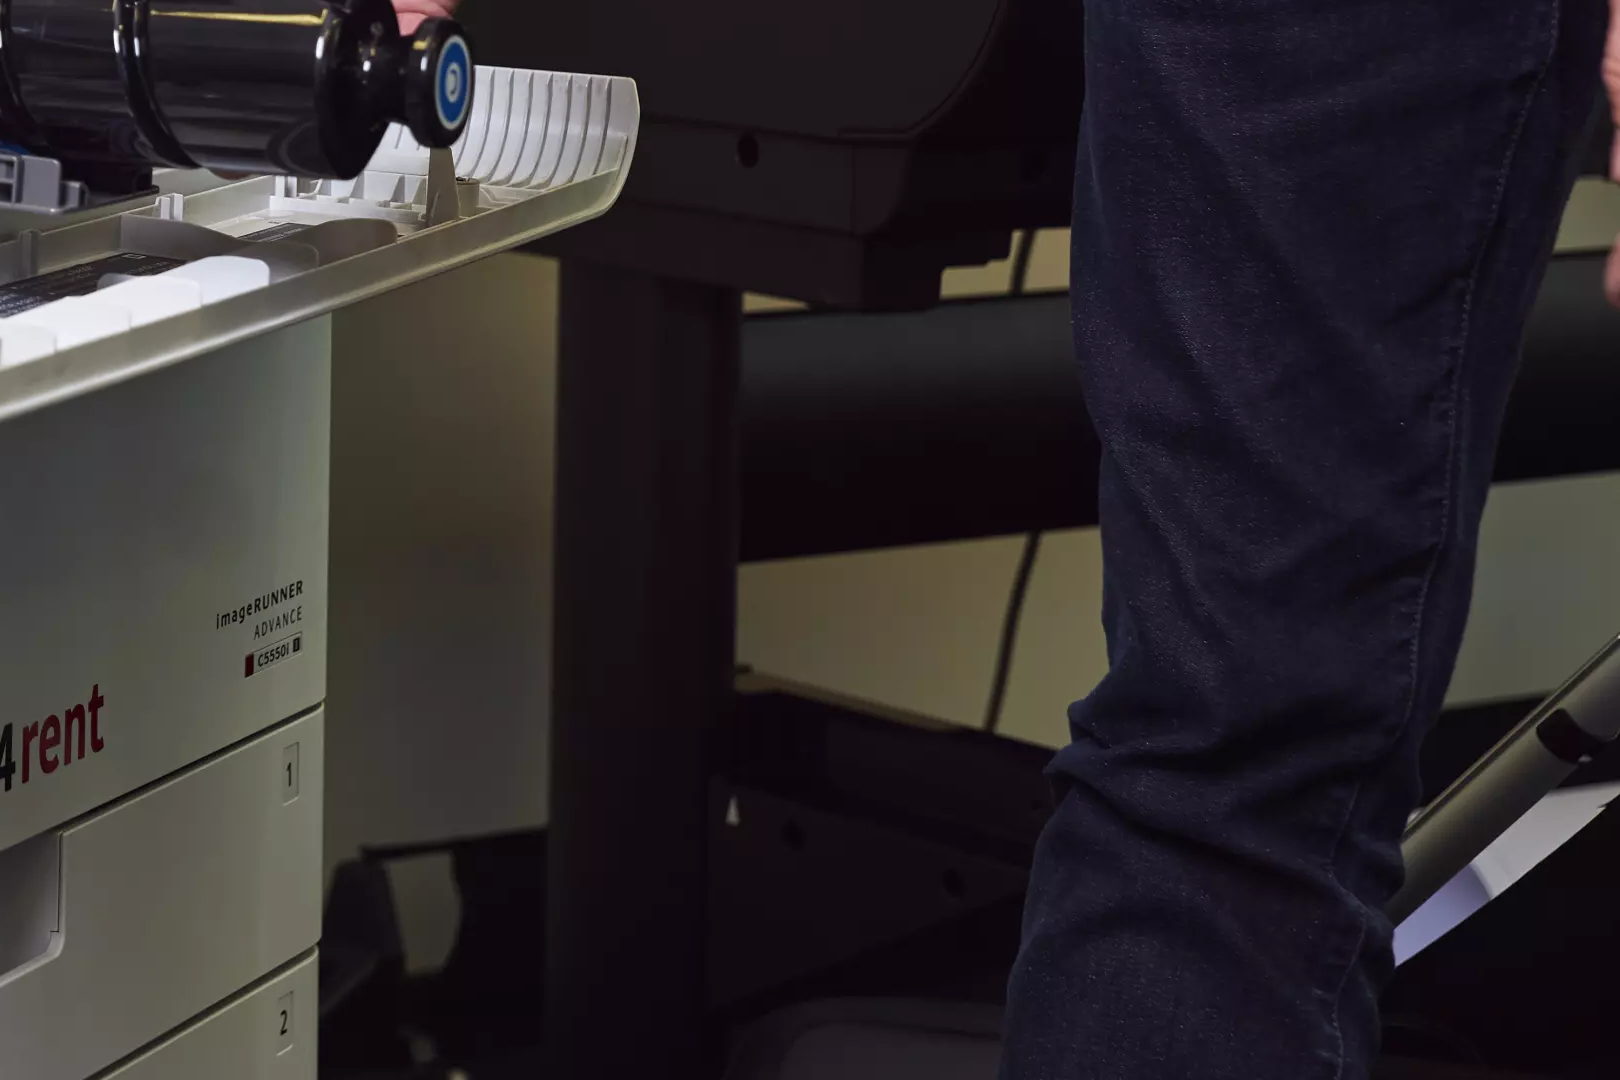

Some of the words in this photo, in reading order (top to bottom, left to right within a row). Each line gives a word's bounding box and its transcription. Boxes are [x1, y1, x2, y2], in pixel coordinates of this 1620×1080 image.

[216, 580, 303, 630] imageRUNNER
[253, 605, 302, 640] ADVANCE
[257, 642, 290, 667] C5550i
[285, 761, 292, 787] 1
[280, 1008, 288, 1036] 2
